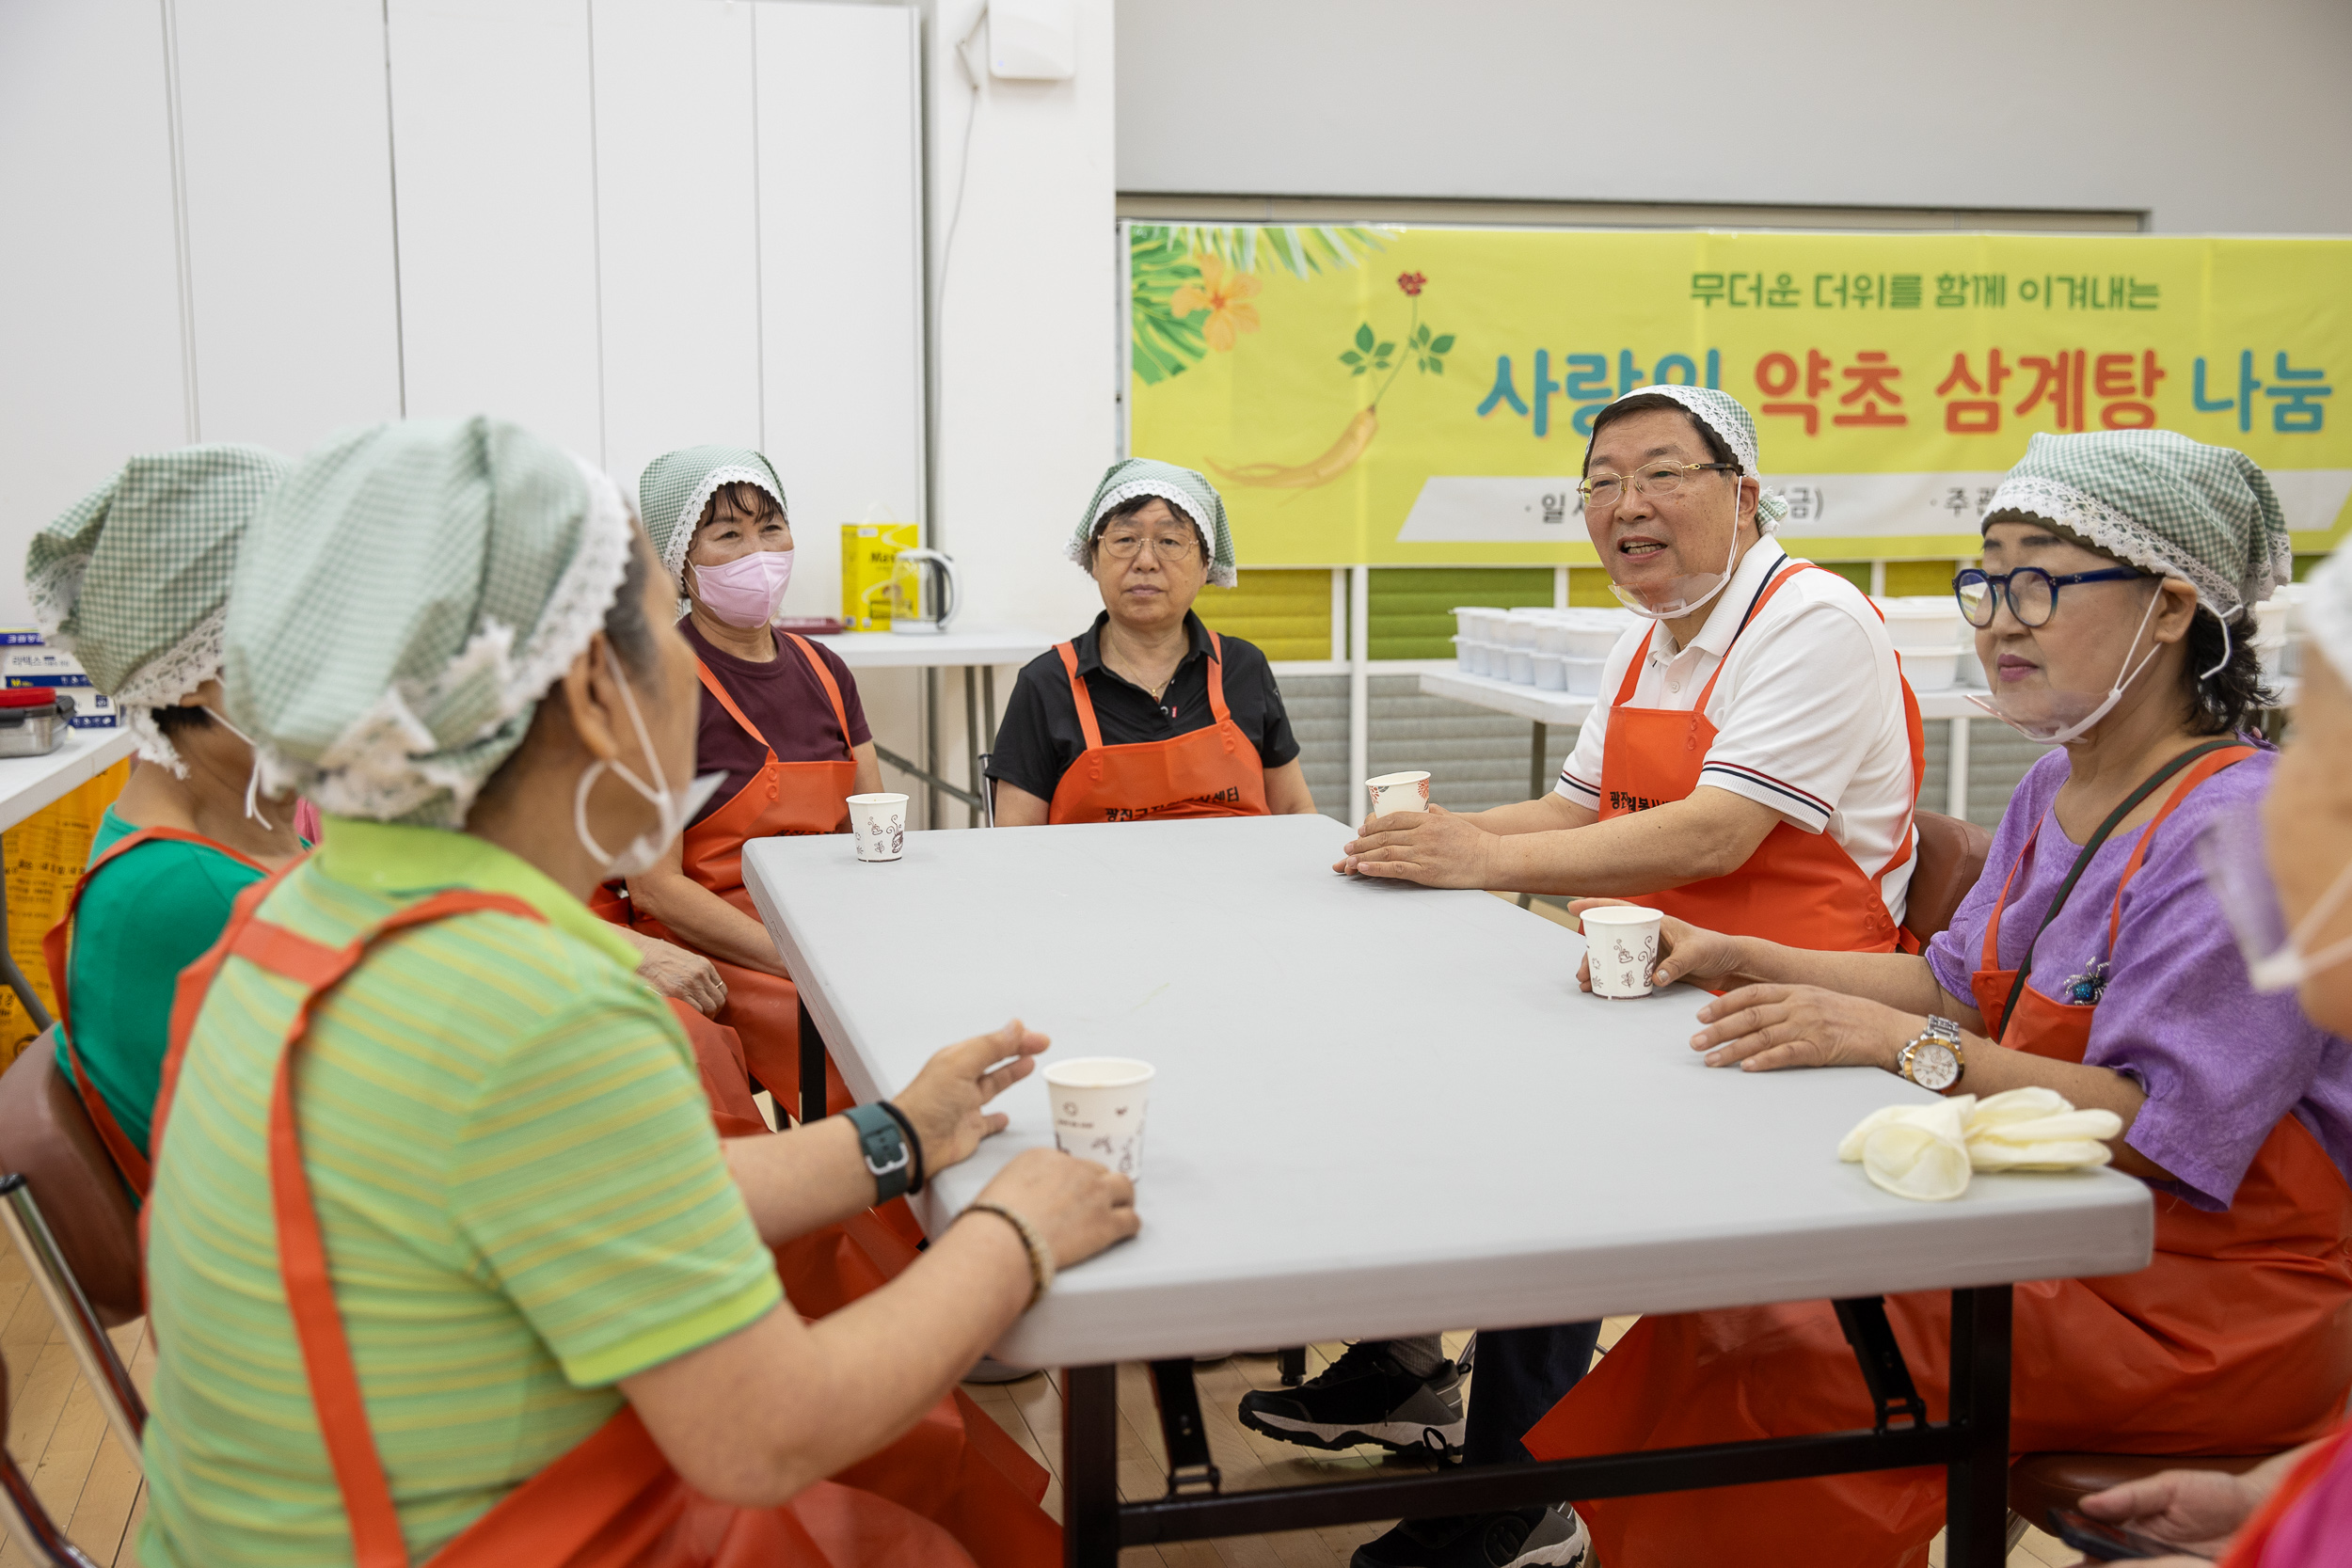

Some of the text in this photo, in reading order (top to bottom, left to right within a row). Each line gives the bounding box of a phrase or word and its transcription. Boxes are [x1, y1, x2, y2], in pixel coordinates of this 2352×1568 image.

[1691, 272, 2160, 310] 무더운 더위를 함께 이겨내는
[1755, 347, 1909, 436] 약초
[1934, 347, 2168, 435] 삼계탕
[2191, 349, 2333, 433] 나눔
